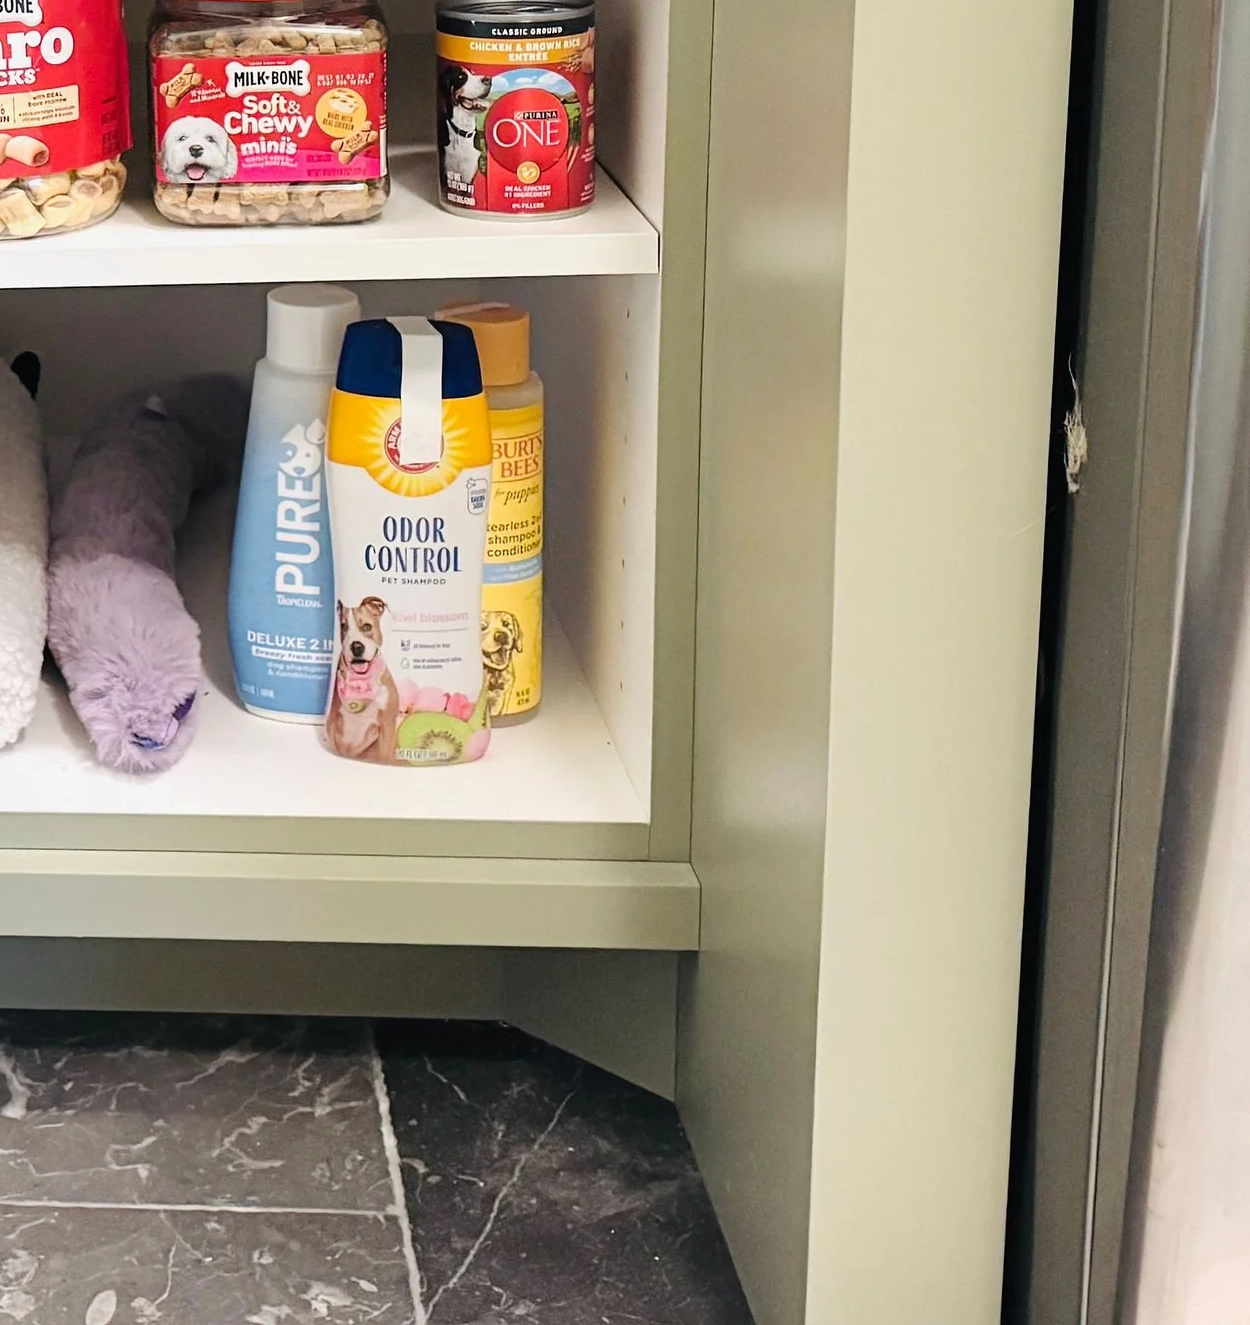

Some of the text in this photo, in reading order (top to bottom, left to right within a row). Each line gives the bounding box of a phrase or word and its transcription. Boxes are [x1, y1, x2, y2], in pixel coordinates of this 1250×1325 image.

[491, 26, 563, 36] CLASSIC GROUND
[470, 38, 581, 52] CHICKEN & BROWN RICE
[524, 111, 558, 119] PURINA
[223, 111, 313, 138] Chewy
[493, 118, 561, 148] ONE
[275, 471, 321, 595] PURE
[383, 515, 445, 543] ODOR
[488, 529, 536, 544] shampoo
[364, 544, 462, 573] CONTROL
[381, 577, 398, 585] PET
[392, 611, 469, 624] kiwi blossom
[247, 630, 307, 649] DELUXE
[309, 638, 320, 650] 2
